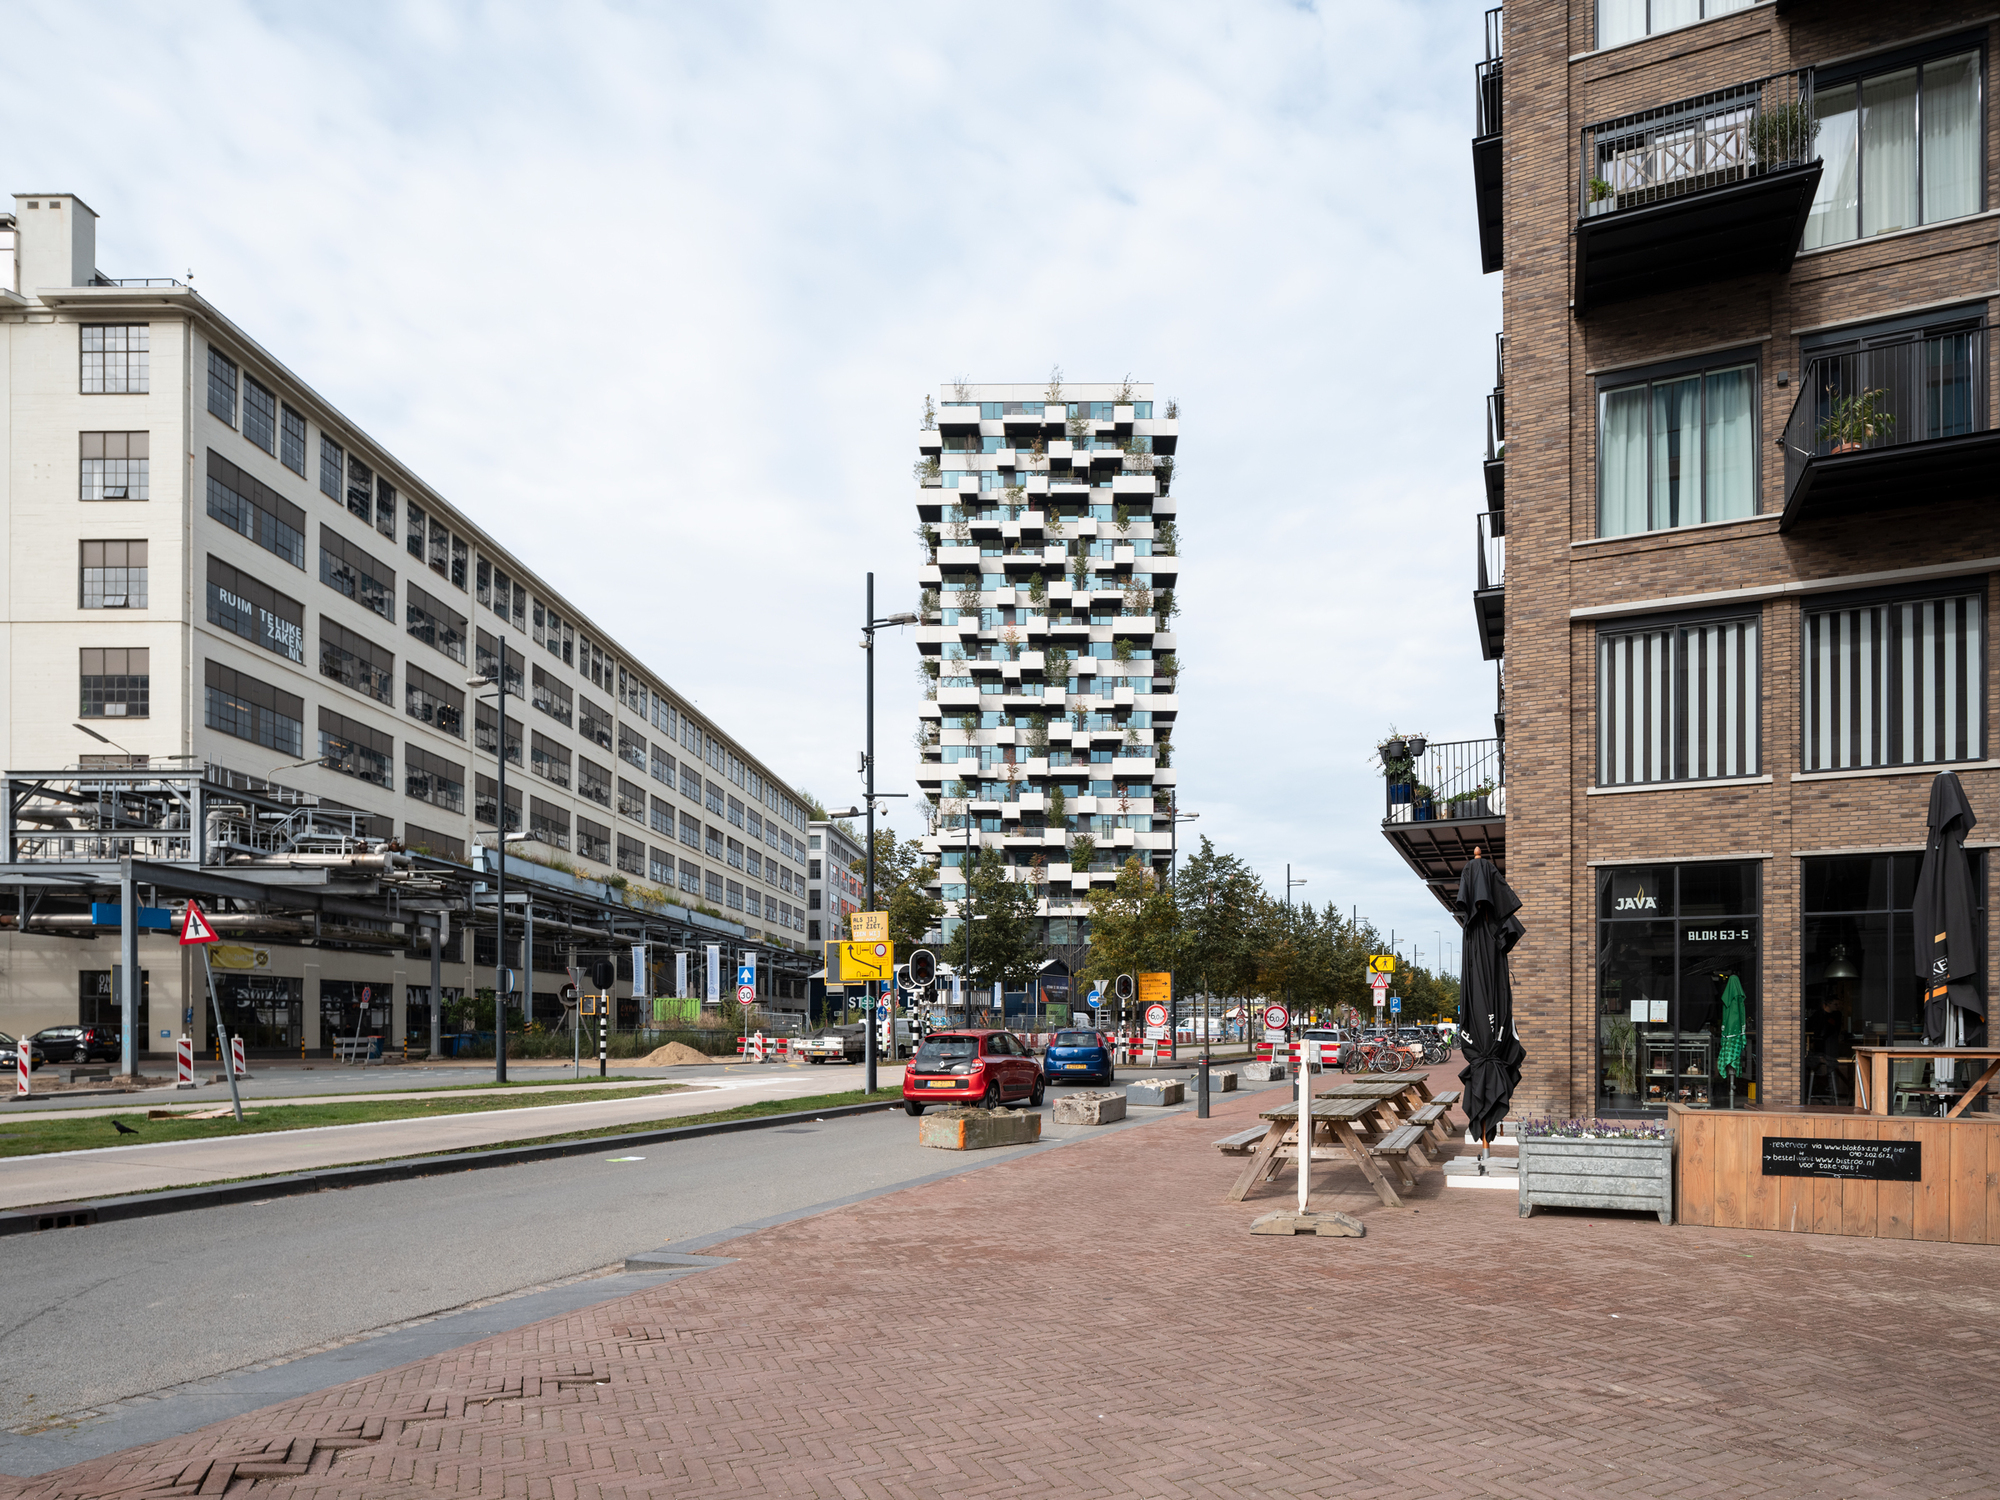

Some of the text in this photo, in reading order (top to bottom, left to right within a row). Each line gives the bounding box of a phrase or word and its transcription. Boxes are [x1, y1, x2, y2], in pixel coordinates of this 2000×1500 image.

[219, 588, 252, 616] RUIM
[267, 624, 303, 652] ZAKEN
[285, 646, 302, 664] .NL
[1615, 897, 1657, 911] JAVA
[866, 916, 878, 924] JIJ
[1688, 930, 1717, 941] BLOK
[741, 992, 751, 1000] 30
[1772, 1154, 1796, 1162] bestel
